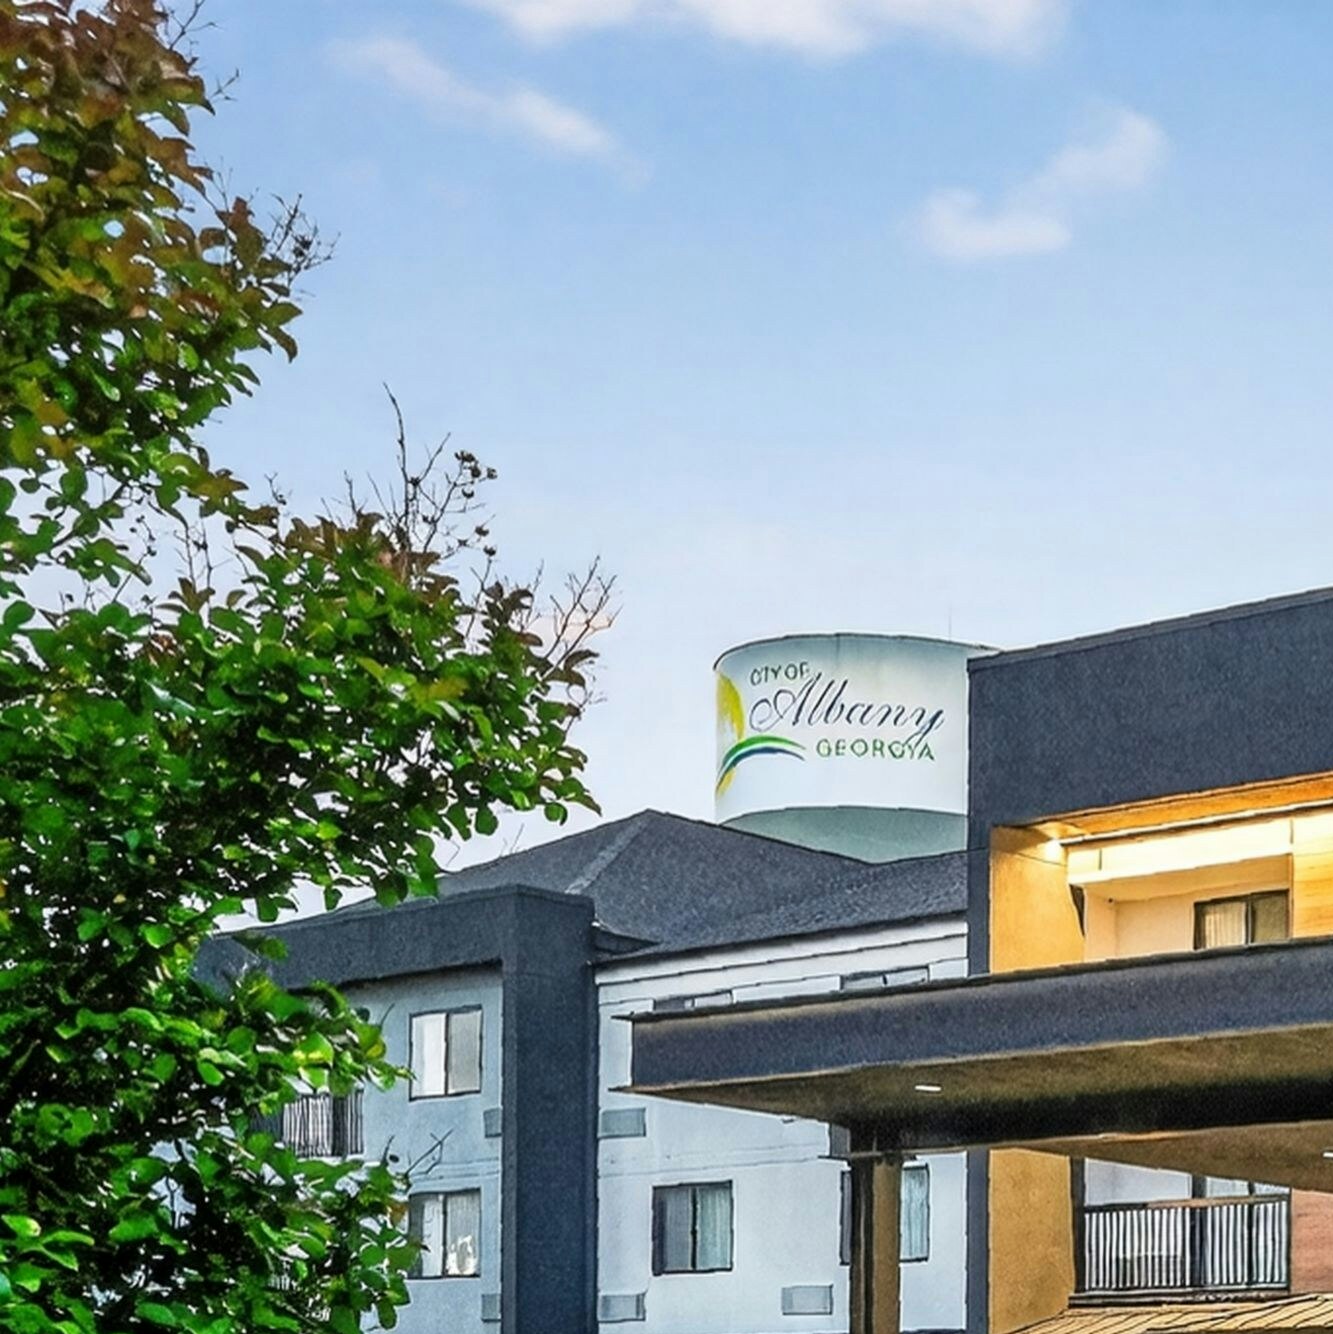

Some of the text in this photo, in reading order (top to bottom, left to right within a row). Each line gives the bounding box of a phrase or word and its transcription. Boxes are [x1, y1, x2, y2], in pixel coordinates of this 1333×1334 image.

[750, 661, 809, 686] CITY OF
[749, 672, 945, 749] Albany
[816, 738, 935, 761] GEORGIA
